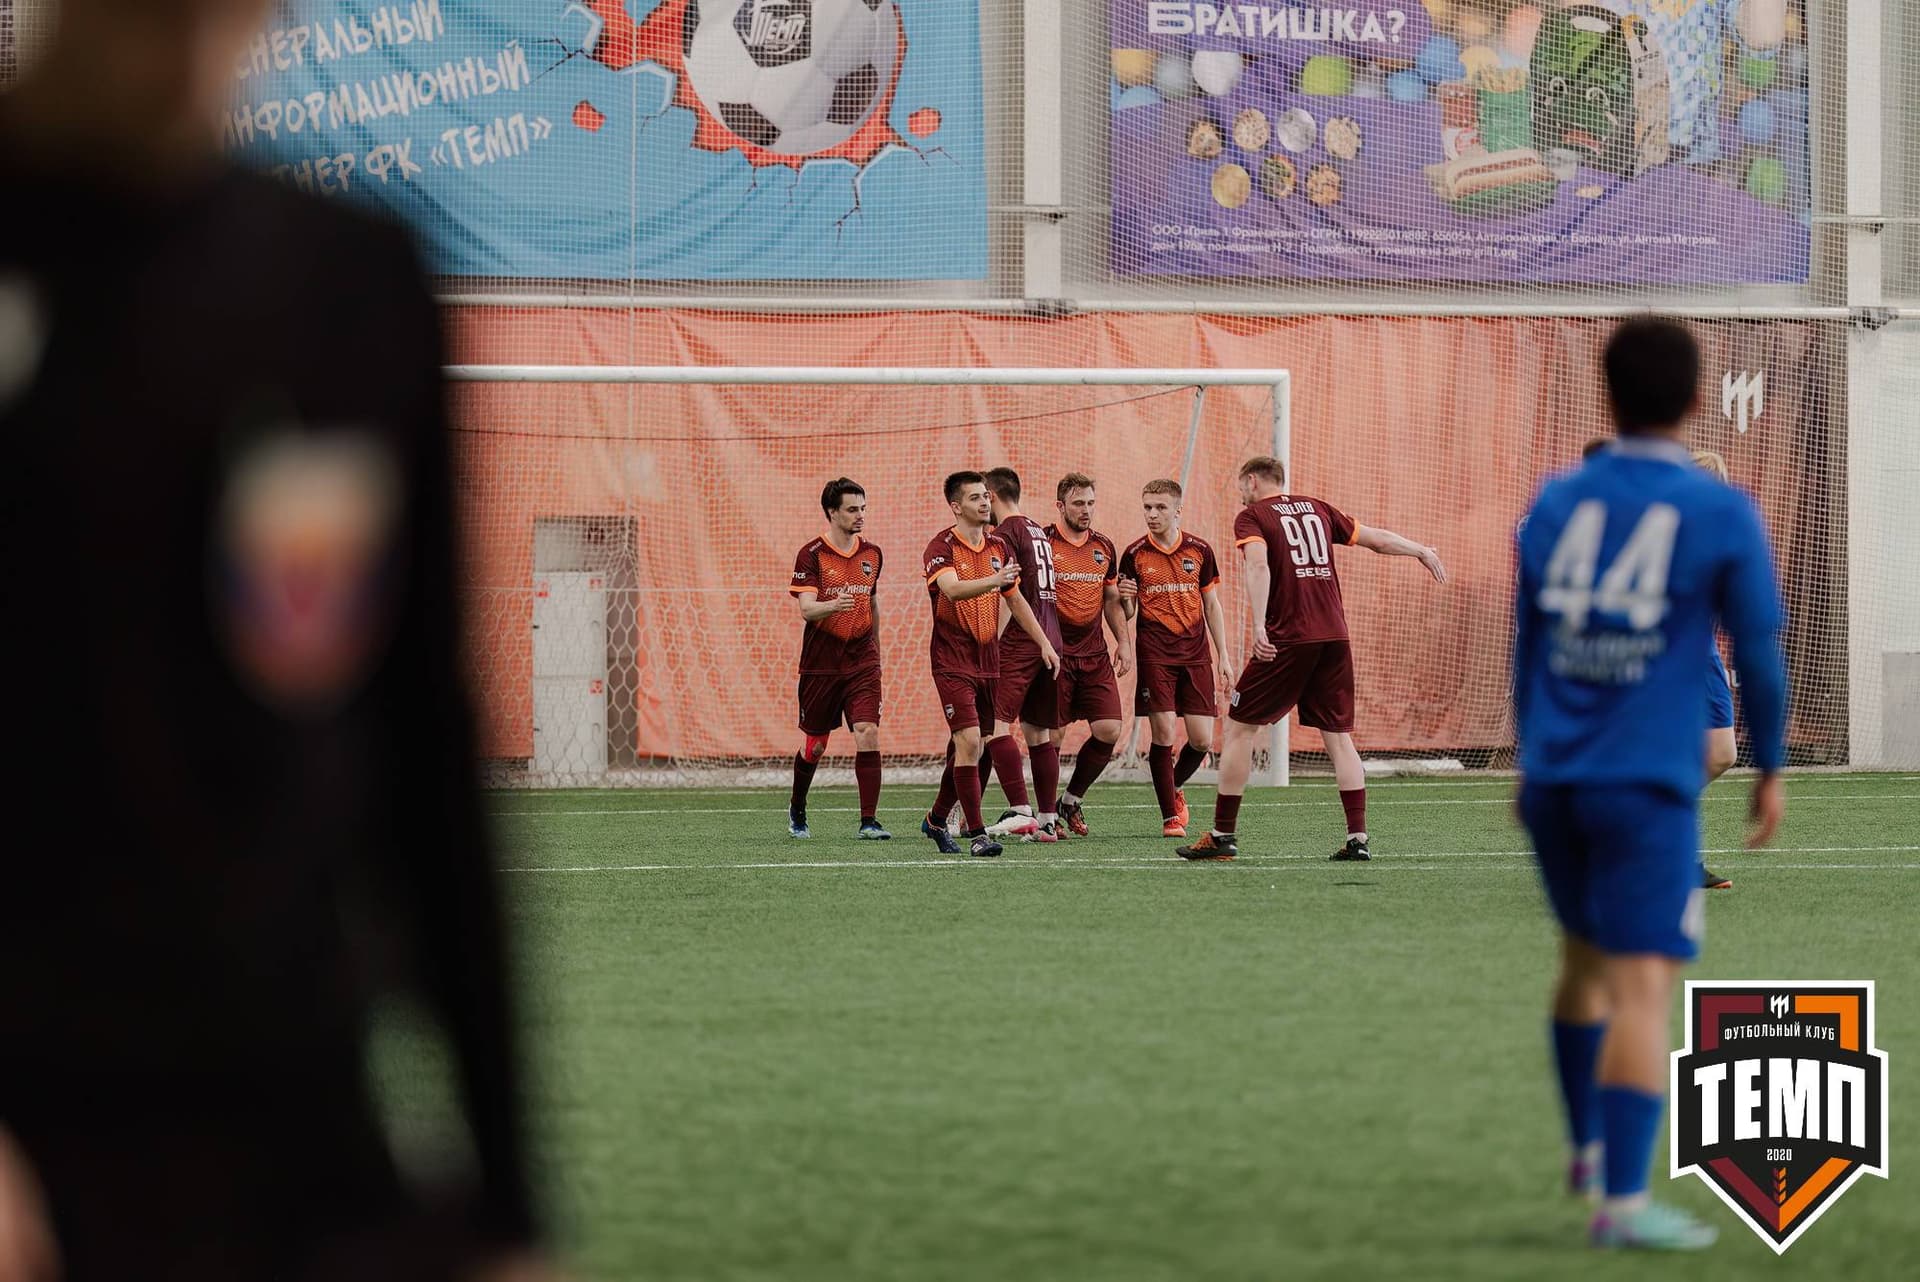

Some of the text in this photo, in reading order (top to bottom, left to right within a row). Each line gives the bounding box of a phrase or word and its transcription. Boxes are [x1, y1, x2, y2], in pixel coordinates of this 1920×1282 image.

[236, 0, 444, 80] ЕНЕРАЛЬНЫЙ
[1149, 2, 1406, 42] БРАТИШКА?
[364, 137, 422, 186] ФК
[431, 112, 553, 170] «ТЕМП»
[1280, 513, 1329, 566] 90
[1538, 498, 1681, 632] 44
